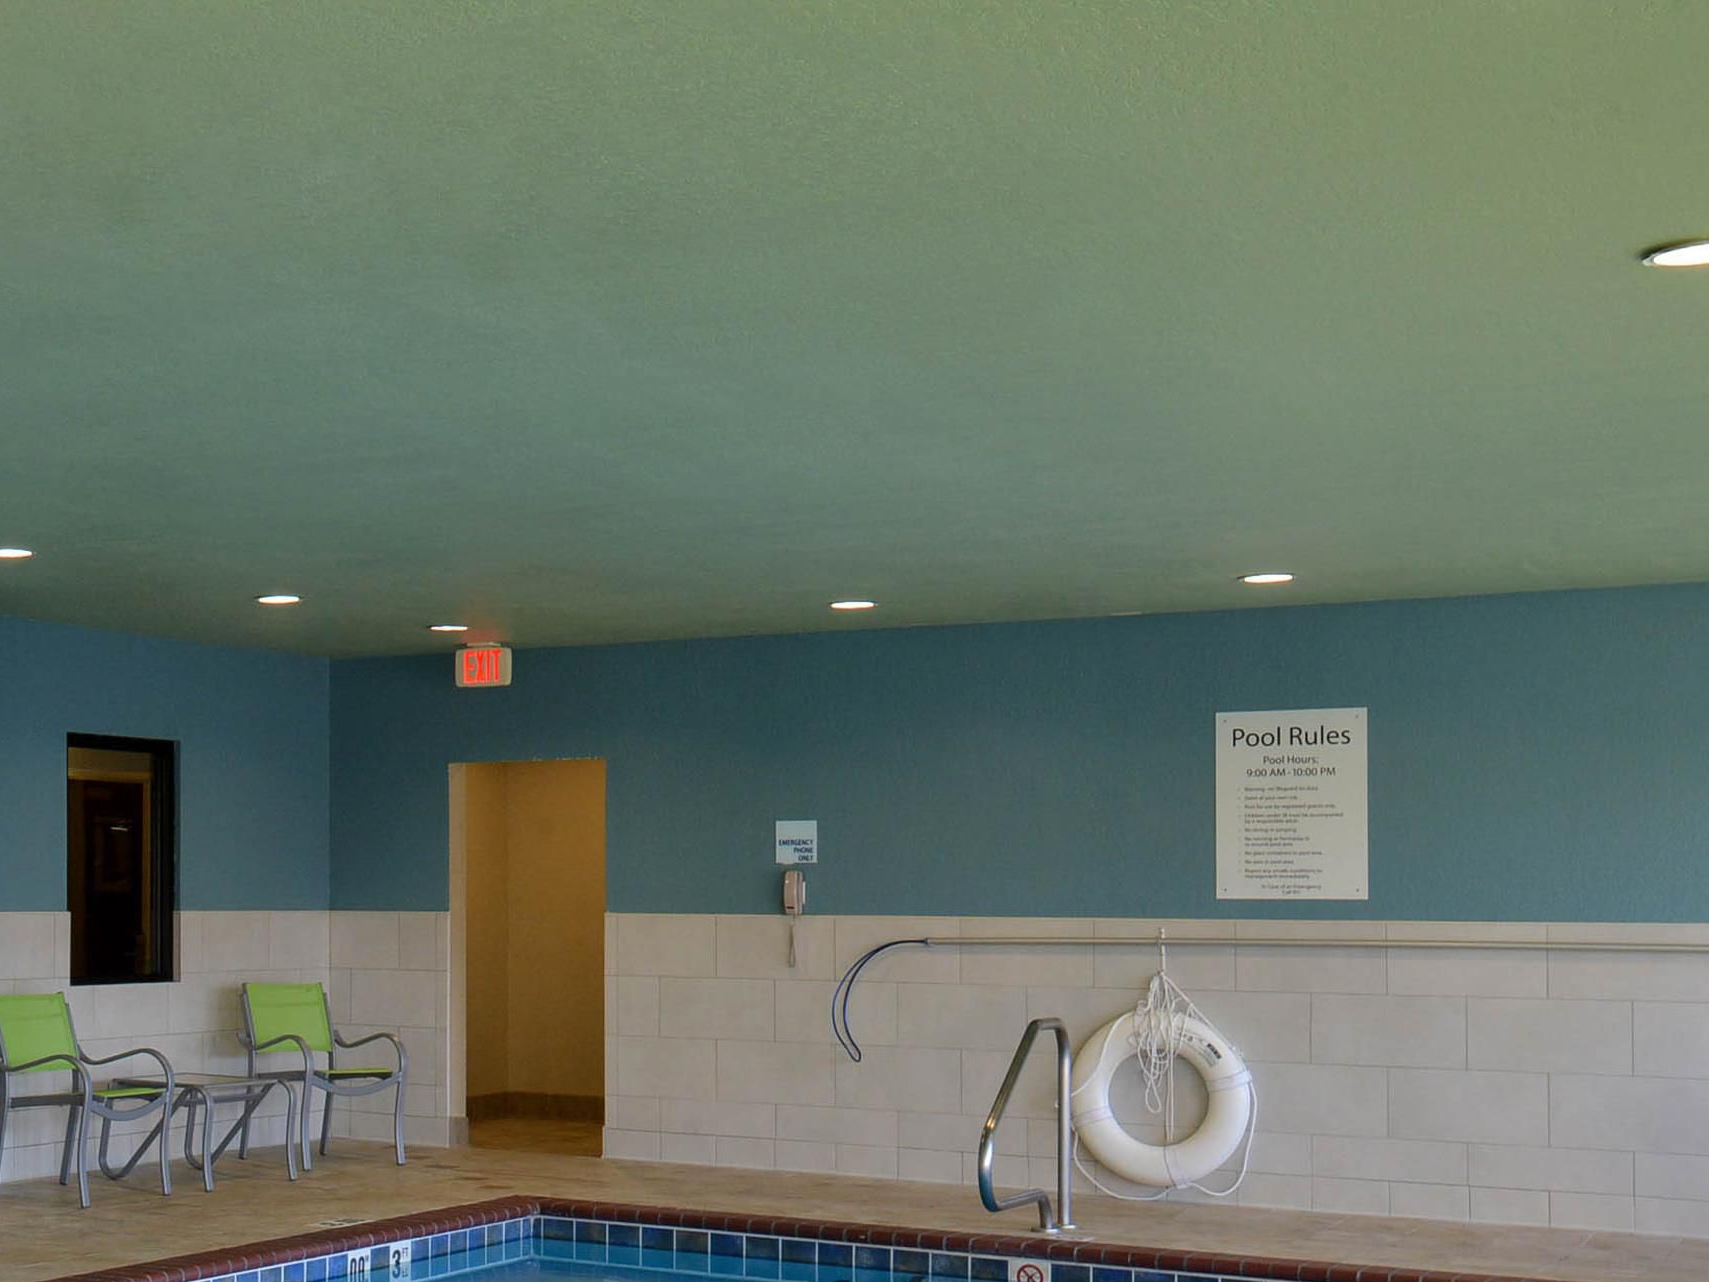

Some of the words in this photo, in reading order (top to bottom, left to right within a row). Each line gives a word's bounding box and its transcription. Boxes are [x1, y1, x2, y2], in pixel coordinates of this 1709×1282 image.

[464, 650, 500, 683] EXIT
[1232, 726, 1281, 747] Pool
[1289, 725, 1352, 746] Rules
[1263, 755, 1285, 765] Pool
[1287, 755, 1319, 764] Hours:
[1246, 768, 1268, 777] 9:00
[1269, 768, 1286, 777] AM
[1292, 767, 1318, 777] 10:00
[1320, 767, 1336, 776] PM
